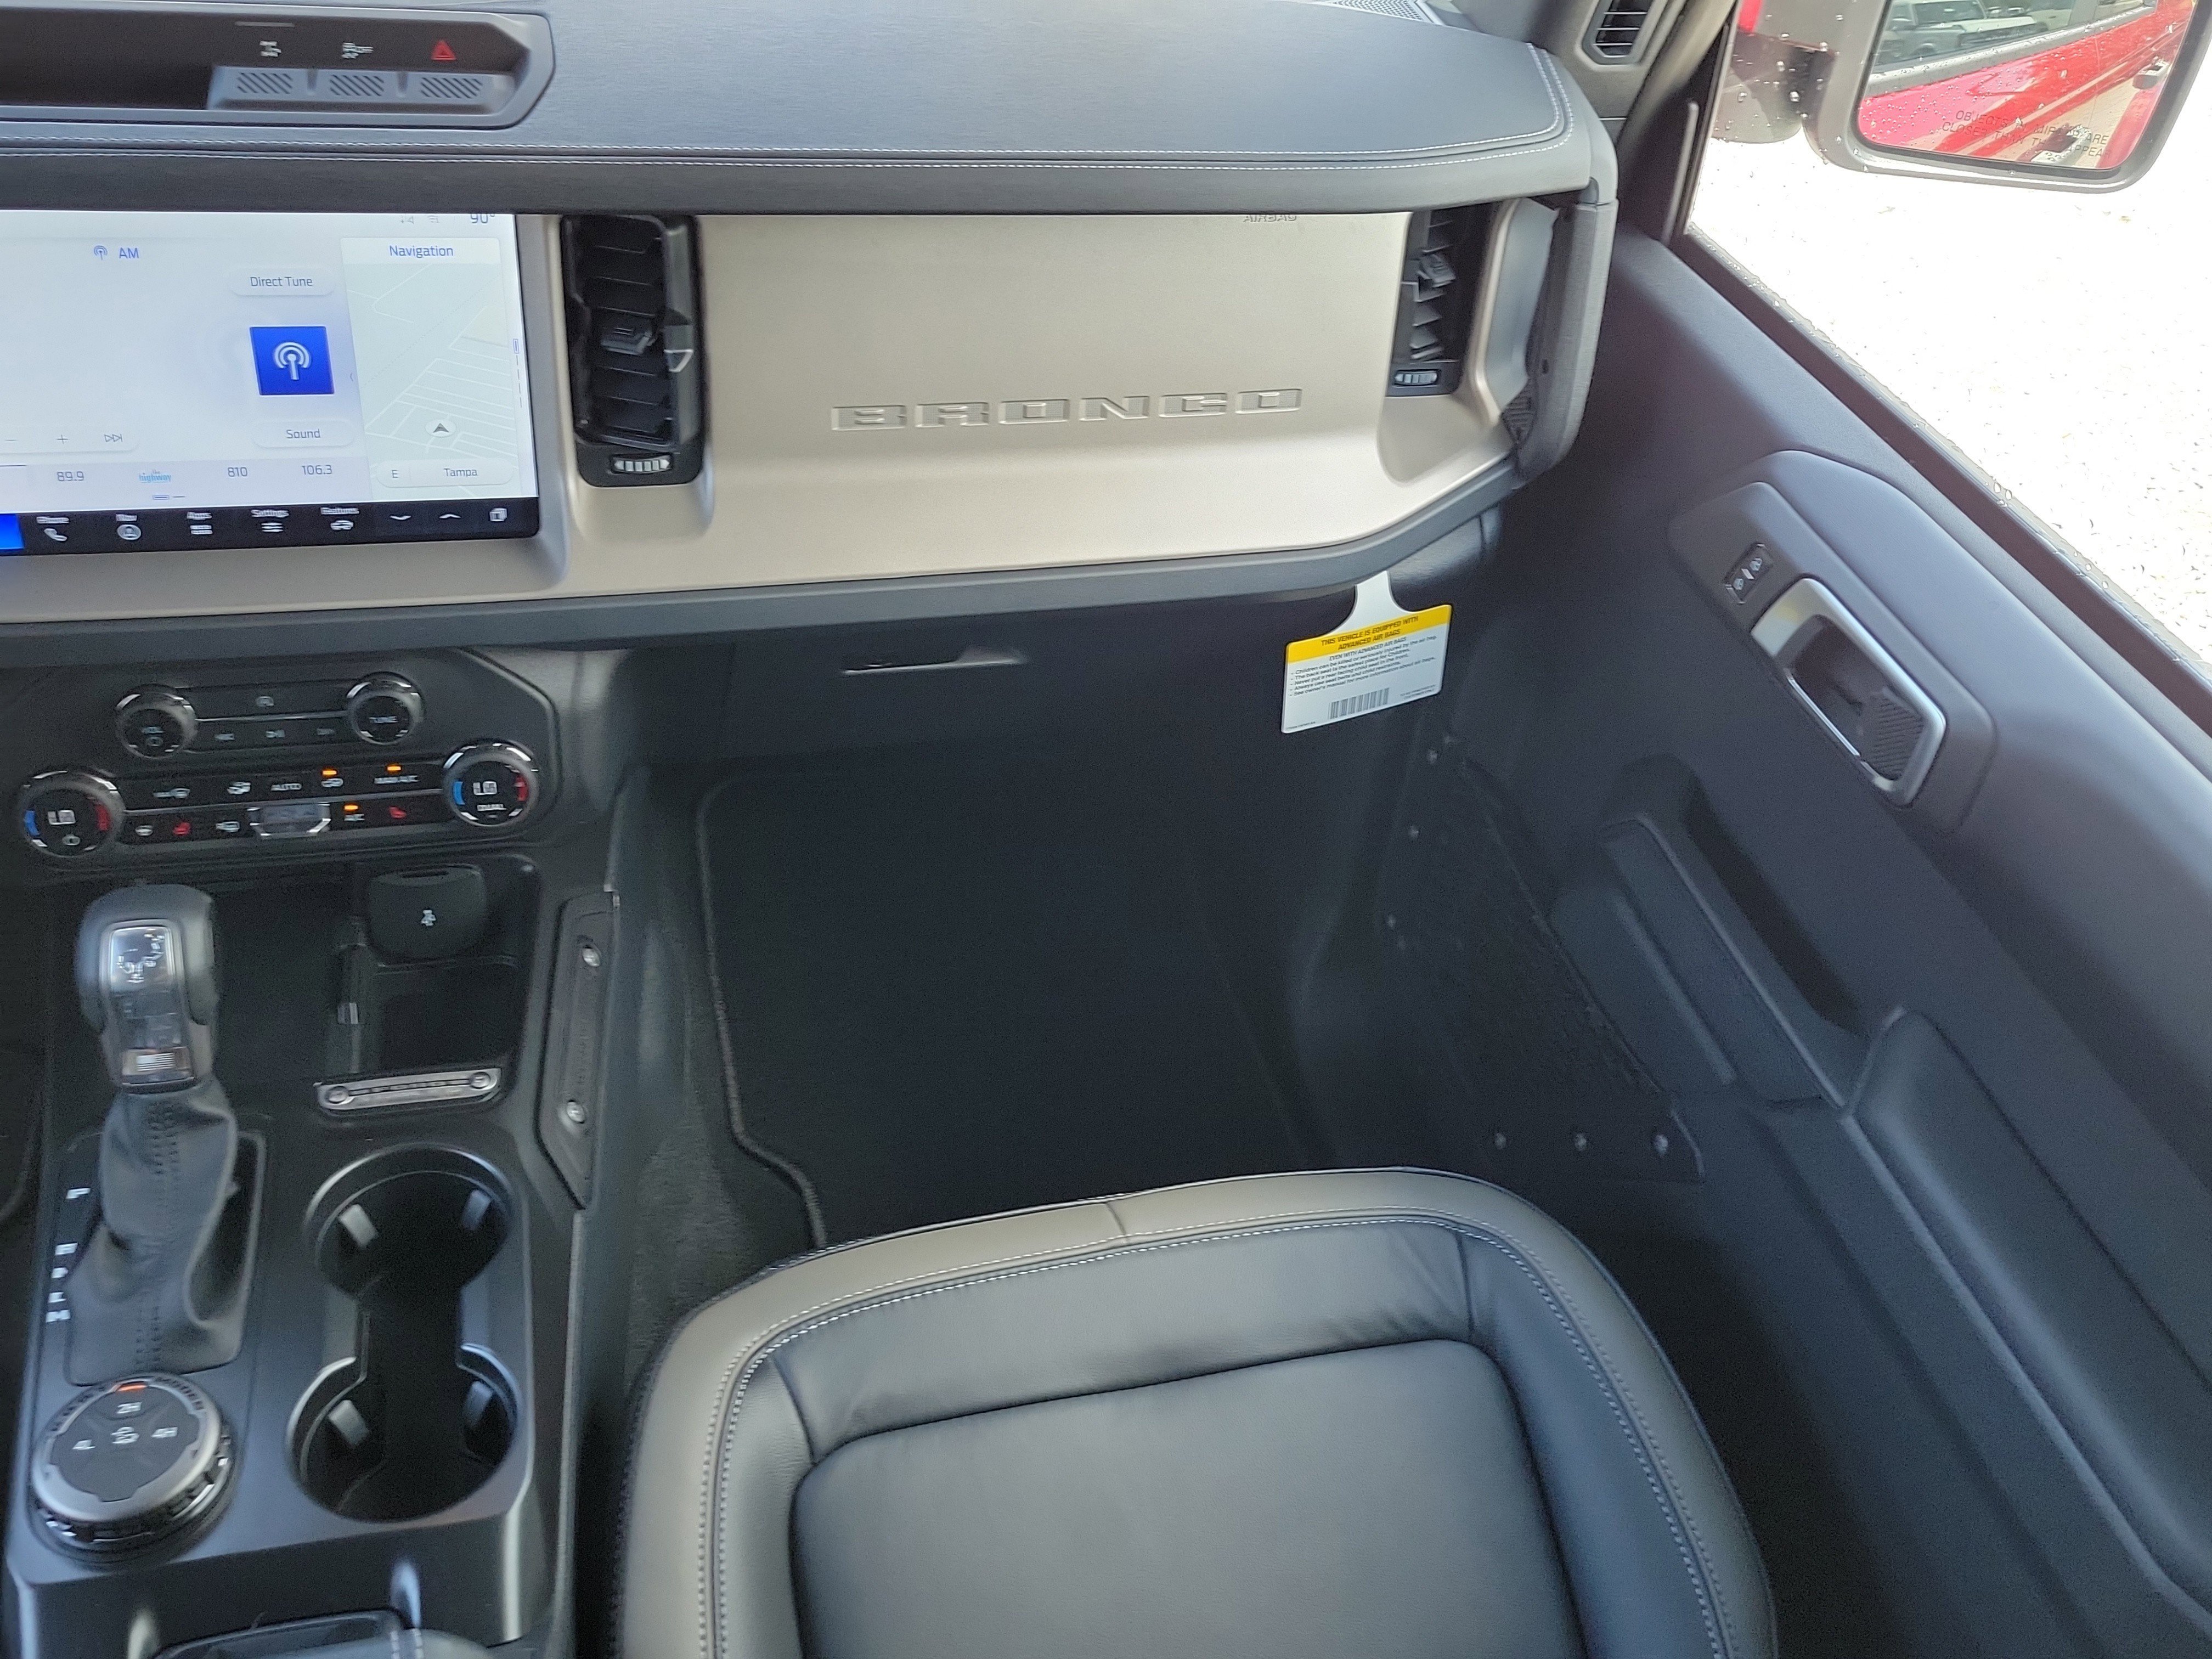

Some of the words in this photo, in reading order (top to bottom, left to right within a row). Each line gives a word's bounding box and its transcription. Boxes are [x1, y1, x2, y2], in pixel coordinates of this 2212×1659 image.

[2086, 132, 2109, 144] ARE
[1243, 214, 1297, 223] AIRBAG
[119, 247, 139, 259] AM
[389, 245, 454, 258] Navigation
[250, 276, 283, 287] Direct
[284, 276, 313, 287] Tune
[831, 387, 1302, 431] BRONCO
[286, 429, 320, 439] Sound
[227, 467, 248, 477] 810
[301, 465, 333, 476] 106.3
[392, 470, 398, 478] E
[444, 468, 478, 477] Tampa
[57, 471, 84, 481] 89.9
[139, 473, 172, 484] highway
[251, 510, 290, 518] Settings
[1321, 637, 1335, 646] THIS
[1337, 631, 1363, 642] VEHICLE
[1372, 620, 1401, 634] EQUIPPED
[1402, 615, 1419, 625] WITH
[1338, 636, 1370, 650] ADVANCED
[1373, 633, 1384, 641] AIR
[1385, 628, 1401, 637] BAGS
[1358, 643, 1383, 653] ADVANCED
[1295, 665, 1318, 674] Children
